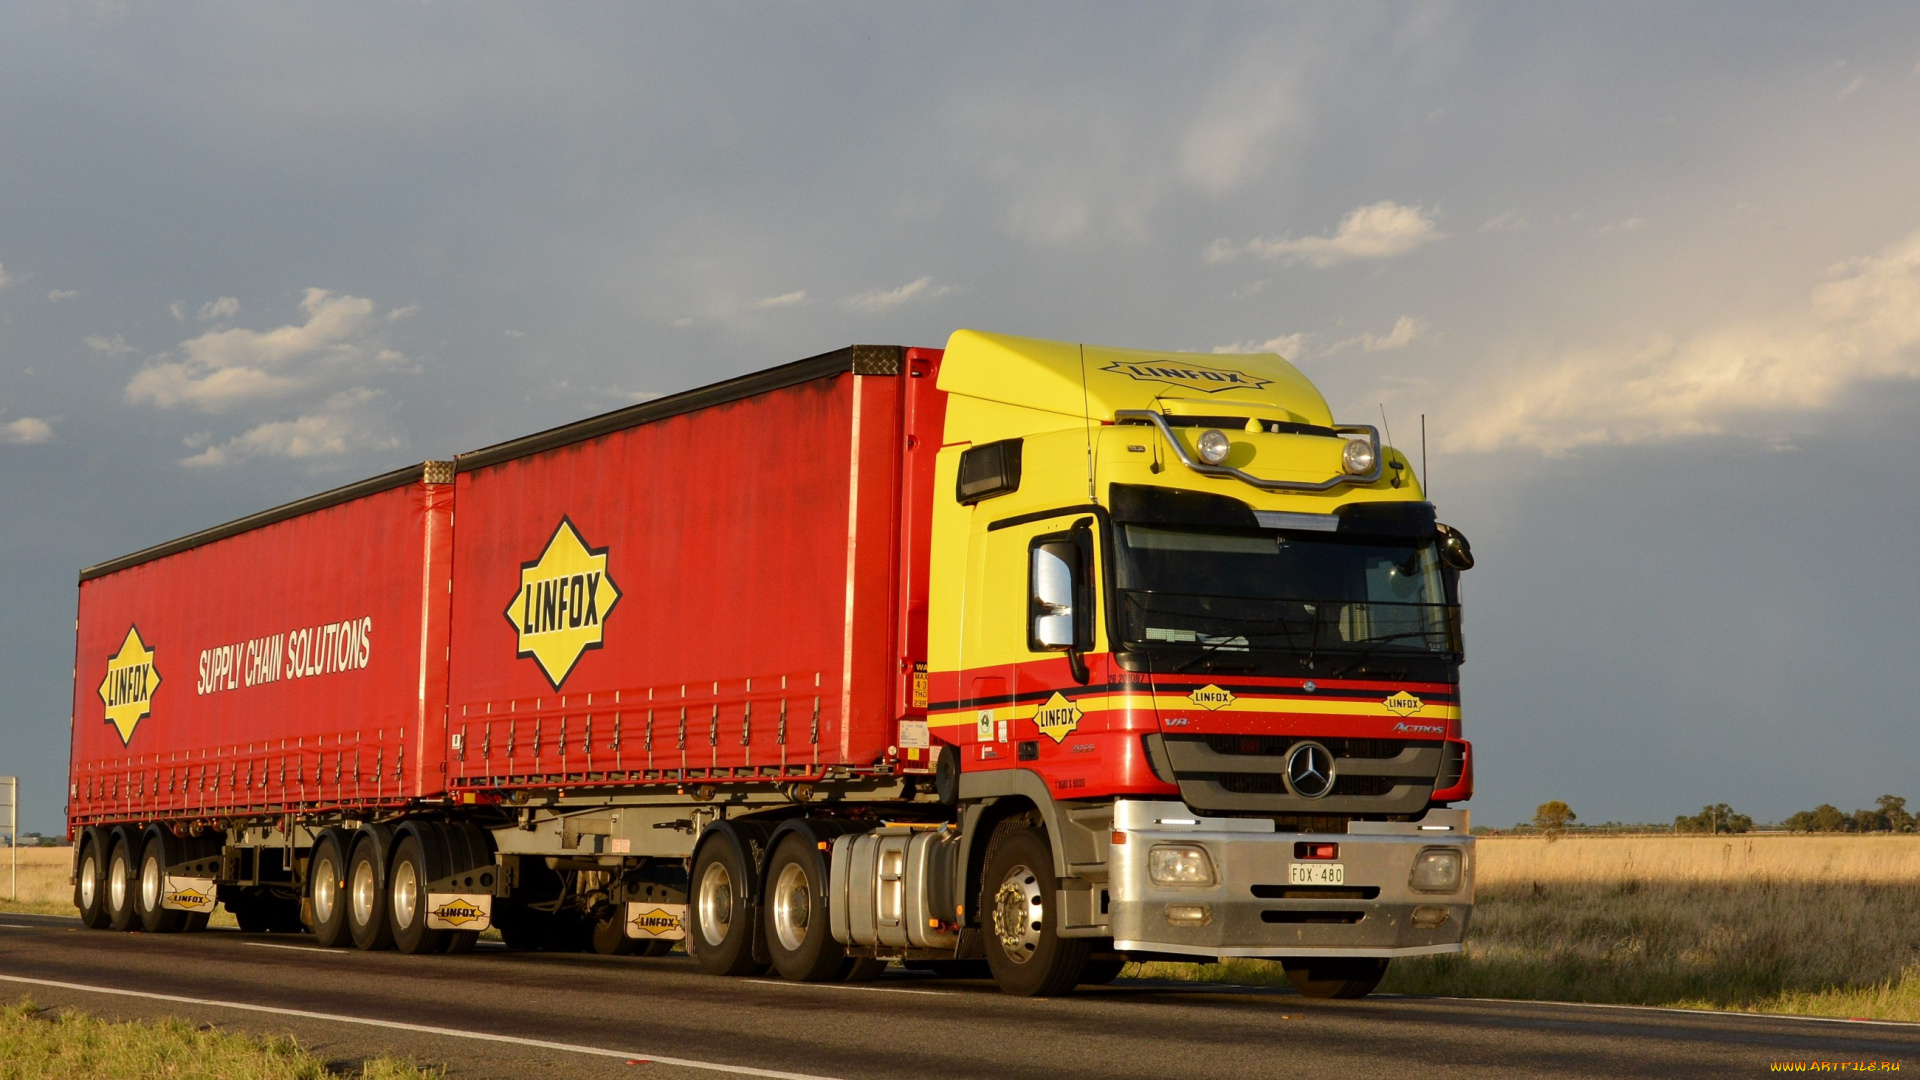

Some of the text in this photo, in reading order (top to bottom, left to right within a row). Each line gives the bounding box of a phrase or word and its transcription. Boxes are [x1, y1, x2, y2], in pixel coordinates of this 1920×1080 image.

[1127, 365, 1249, 384] LINFOX
[522, 571, 602, 636] LINFOX
[197, 615, 372, 696] SUPPLY CHAIN SOLUTIONS
[108, 661, 150, 707] LINFOX
[1195, 692, 1229, 702] LINFOX
[1389, 699, 1418, 708] LINFOX
[1040, 708, 1074, 727] LINFOX
[1165, 718, 1188, 726] V8
[173, 894, 204, 905] LINFOX
[441, 906, 476, 918] LINFOX
[641, 917, 675, 928] LINFOX
